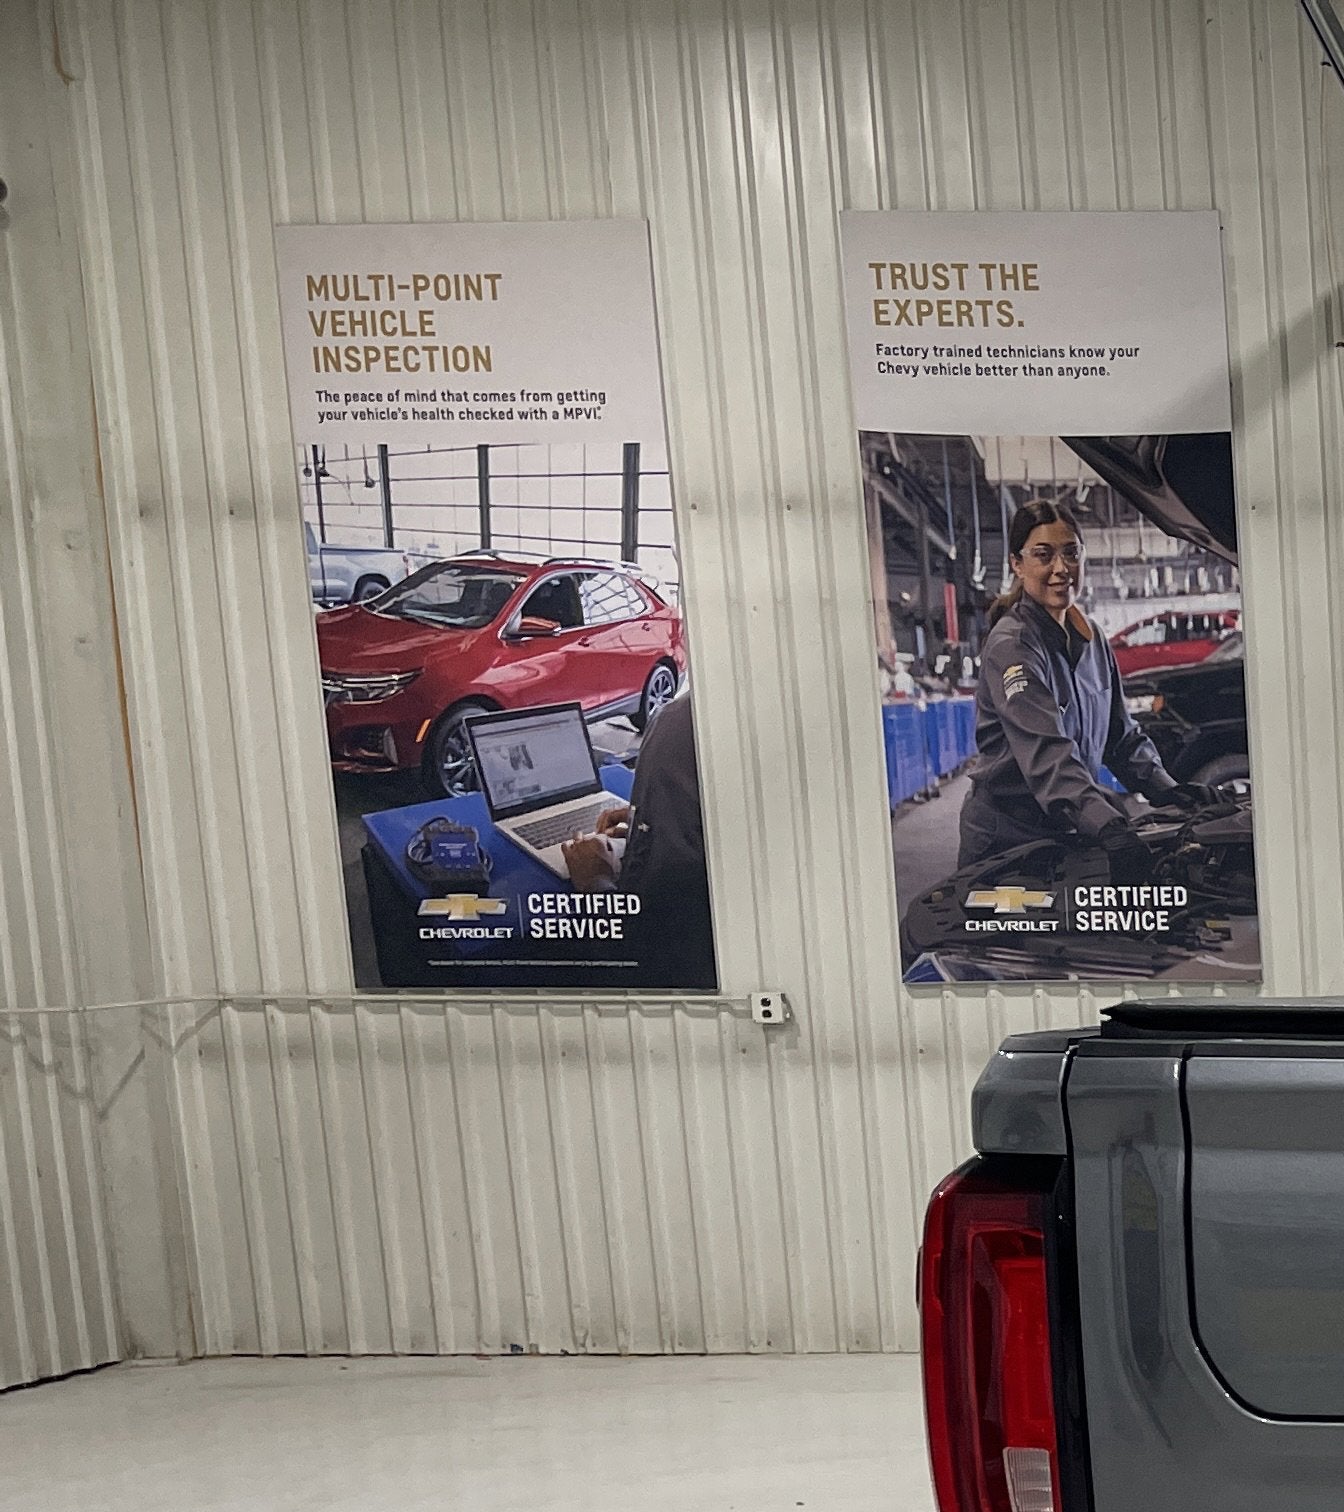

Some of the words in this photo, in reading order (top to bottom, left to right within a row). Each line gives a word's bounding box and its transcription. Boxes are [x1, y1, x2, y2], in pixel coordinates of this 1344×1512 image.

[869, 263, 968, 291] TRUST
[979, 264, 1040, 291] THE
[306, 274, 502, 302] MULTI-POINT
[308, 309, 436, 337] VEHICLE
[873, 299, 1025, 327] EXPERTS.
[313, 345, 492, 373] INSPECTION
[876, 343, 929, 359] Factory
[933, 344, 982, 357] trained
[987, 344, 1065, 358] technicians
[1069, 344, 1105, 357] know
[1109, 347, 1140, 360] your
[877, 361, 920, 378] Chevy
[923, 362, 971, 376] vehicle
[975, 363, 1018, 376] better
[1022, 363, 1053, 376] than
[1057, 366, 1110, 379] anyone.
[315, 389, 340, 402] The
[344, 392, 383, 406] peace
[387, 389, 400, 402] of
[404, 389, 437, 402] mind
[441, 389, 469, 402] that
[473, 392, 516, 402] comes
[520, 389, 552, 402] from
[557, 389, 606, 404] getting
[318, 410, 347, 424] your
[351, 407, 408, 421] vehicle's
[412, 407, 454, 420] health
[459, 407, 514, 420] checked
[517, 407, 547, 420] with
[552, 410, 559, 420] a
[527, 894, 641, 915] CERTIFIED
[1074, 886, 1188, 907] CERTIFIED
[530, 918, 624, 939] SERVICE
[965, 920, 1060, 932] CHEVROLET
[1075, 910, 1170, 932] SERVICE
[419, 927, 514, 940] CHEVROLET
